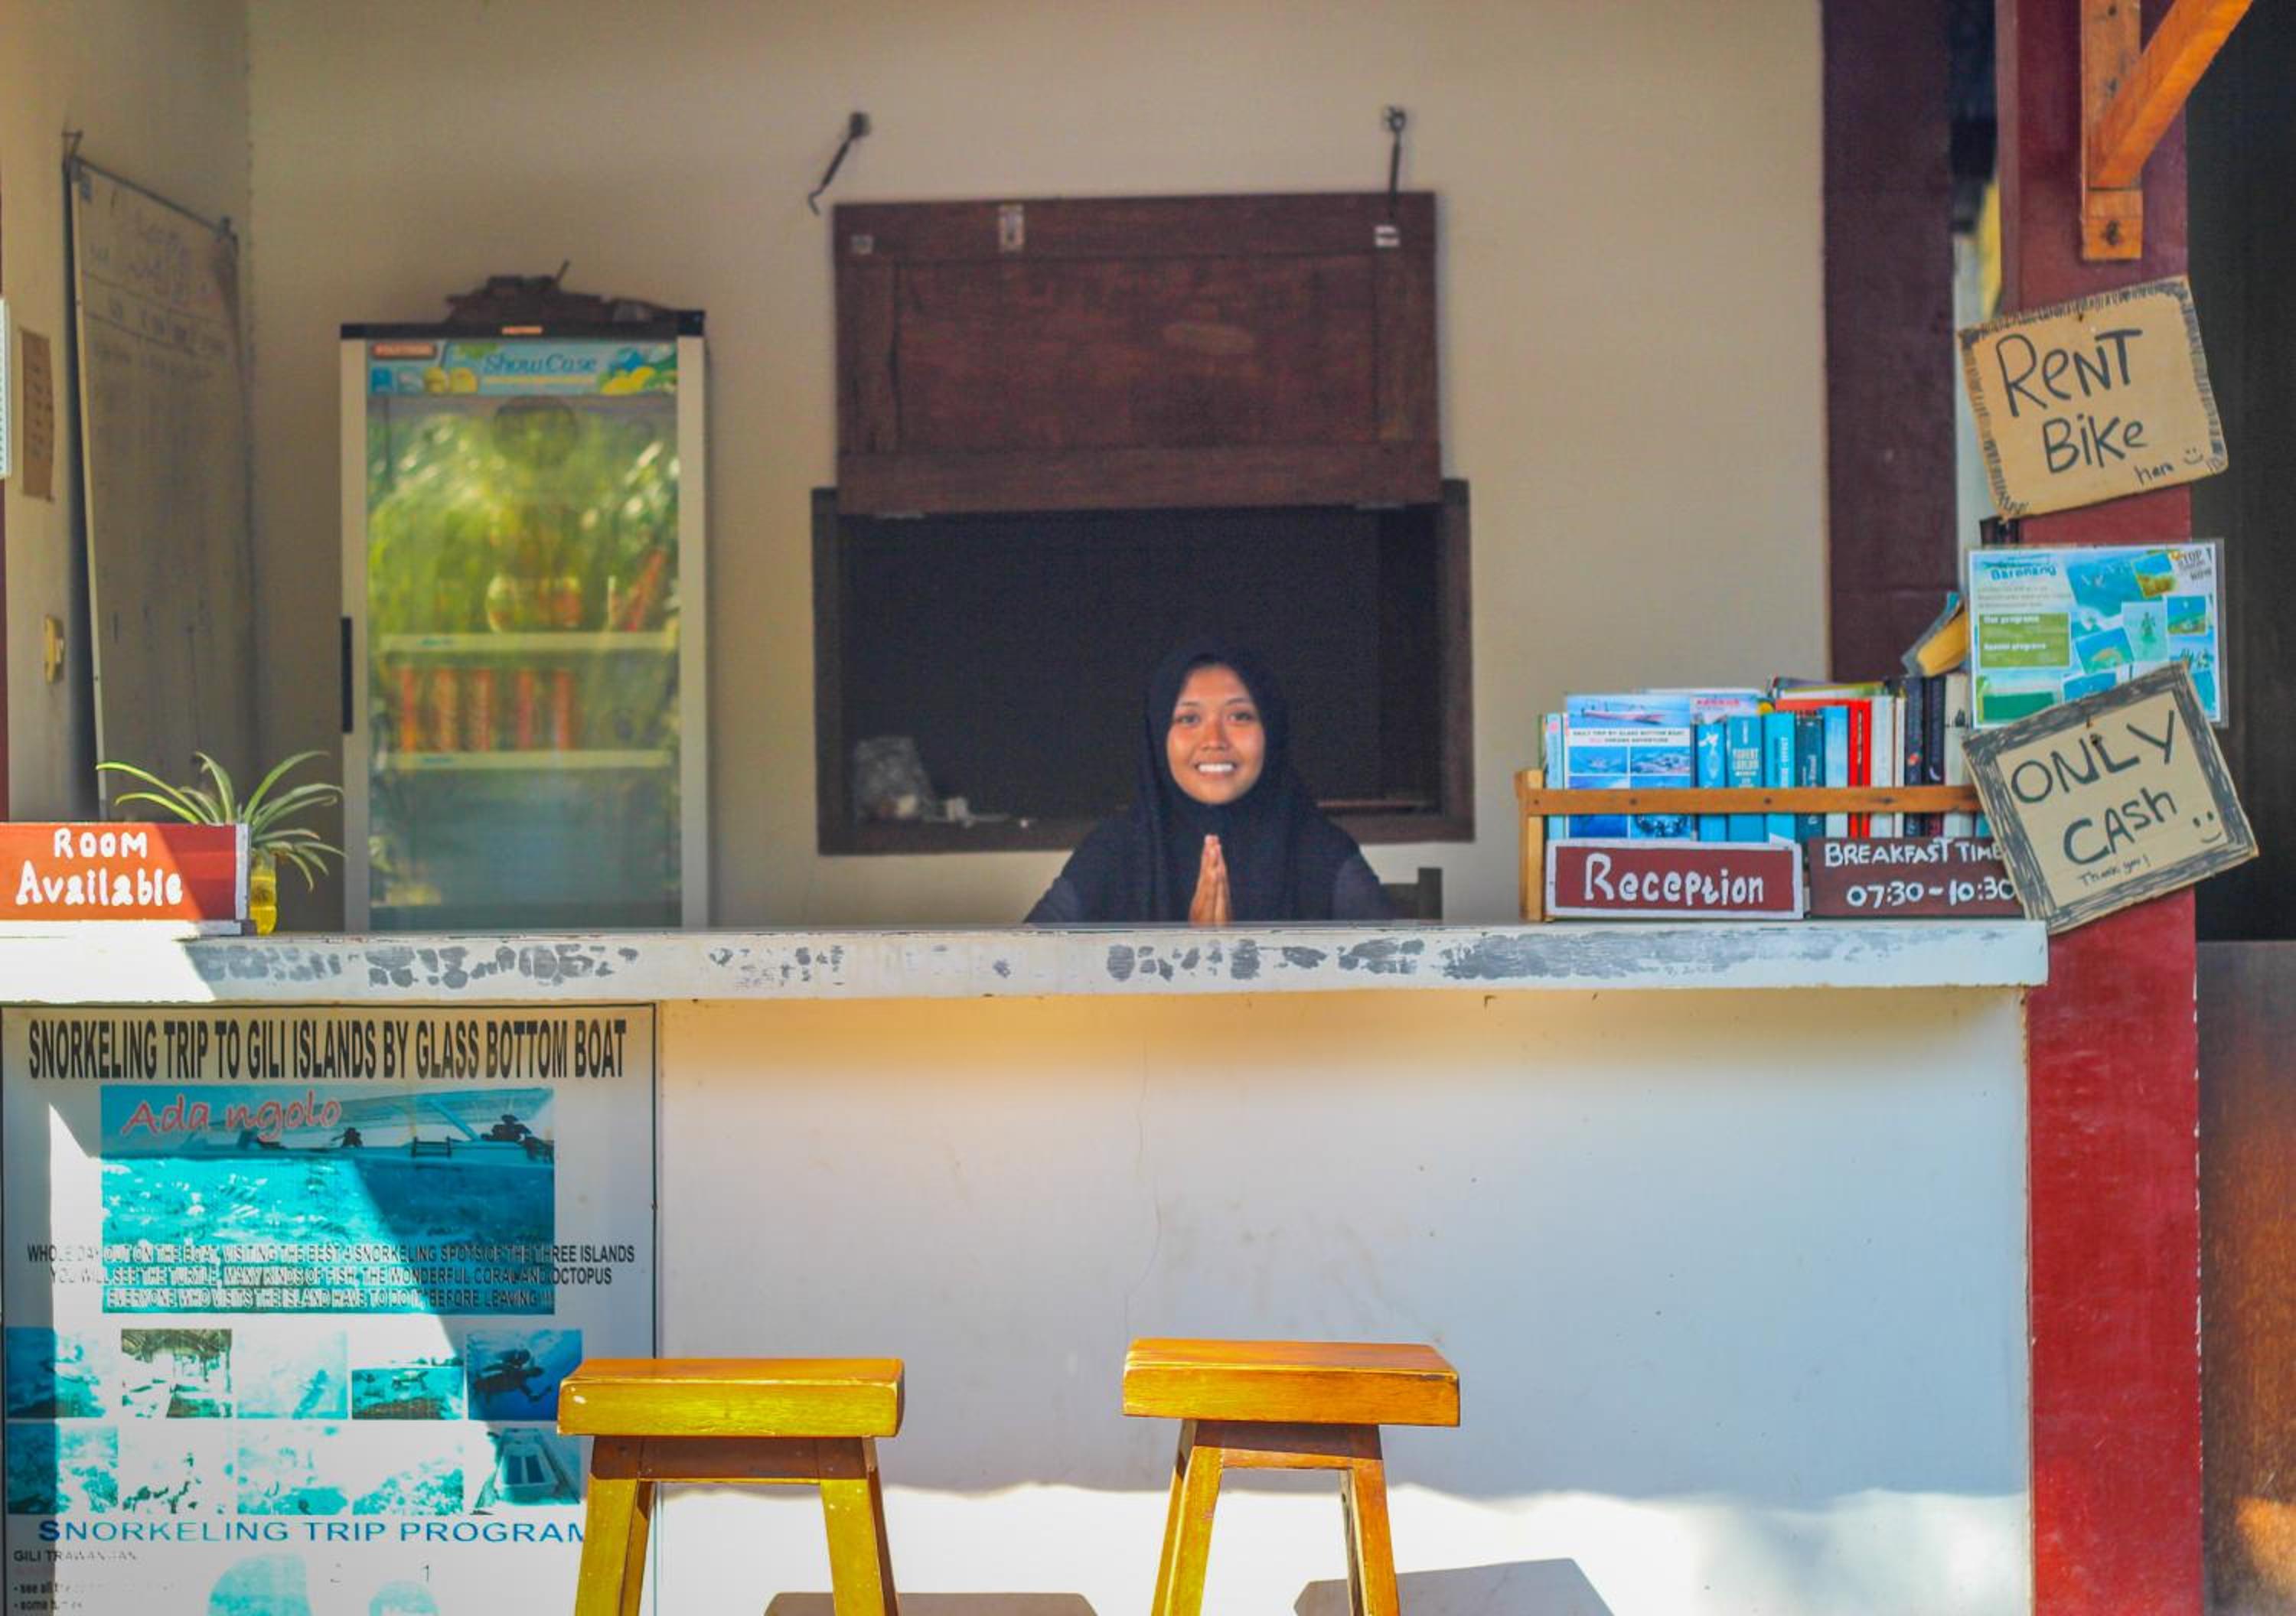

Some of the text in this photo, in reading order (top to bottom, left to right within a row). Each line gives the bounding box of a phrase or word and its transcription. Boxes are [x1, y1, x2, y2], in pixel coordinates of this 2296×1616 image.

[2011, 709, 2175, 803] ONLY
[1824, 836, 2004, 868] BREAKFAST TIME
[15, 859, 184, 907] Available
[1583, 852, 1764, 907] Reception
[29, 1020, 627, 1080] SNORKELING TRIP TO GILI ISLANDS BY GLASS BOTTOM BOAT
[121, 1090, 342, 1141] Ada ngolo
[156, 1244, 180, 1262] THE
[280, 1244, 304, 1262] THE
[308, 1244, 341, 1262] BEST
[354, 1244, 436, 1262] SNORKELING
[440, 1244, 484, 1262] SPOTS
[580, 1244, 635, 1262] ISLANDS
[113, 1266, 137, 1286] SEE
[142, 1266, 167, 1286] THE
[305, 1266, 322, 1286] OF
[363, 1266, 386, 1286] THE
[389, 1266, 470, 1286] WONDERFUL
[474, 1266, 517, 1286] CORAL
[550, 1266, 612, 1286] OCTOPUS
[178, 1289, 210, 1308] WHO
[255, 1289, 281, 1308] THE
[282, 1289, 330, 1308] ISLAND
[331, 1289, 365, 1308] HAVE
[370, 1289, 387, 1308] TO
[429, 1289, 479, 1308] BEFORE
[484, 1289, 536, 1308] LEAVING
[38, 1519, 289, 1543] SNORKELING
[302, 1521, 386, 1542] TRIP
[13, 1549, 41, 1562] GILI
